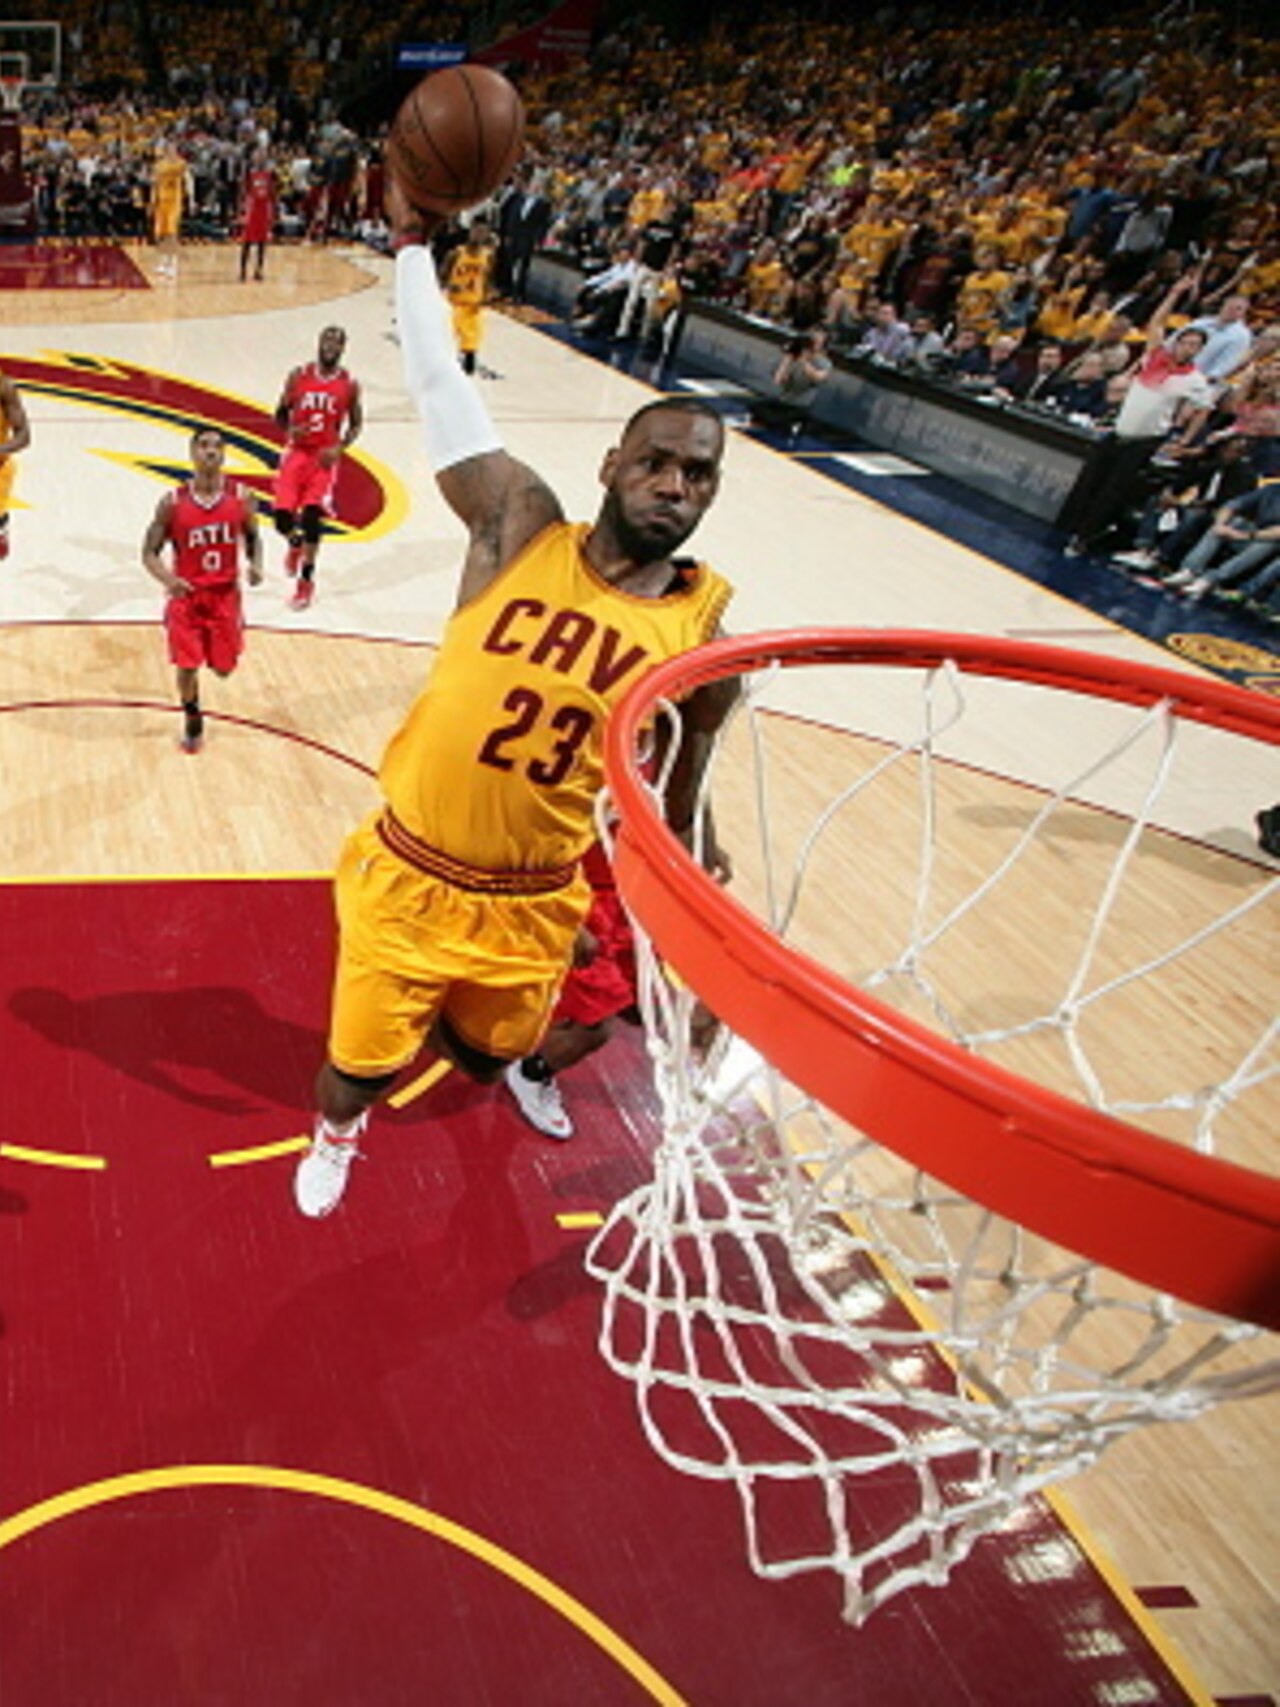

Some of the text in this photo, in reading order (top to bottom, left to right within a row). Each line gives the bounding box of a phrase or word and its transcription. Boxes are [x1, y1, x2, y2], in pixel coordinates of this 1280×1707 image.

[189, 522, 234, 549] ATL
[201, 551, 223, 572] 0
[482, 598, 649, 695] CAV
[477, 685, 595, 787] 23
